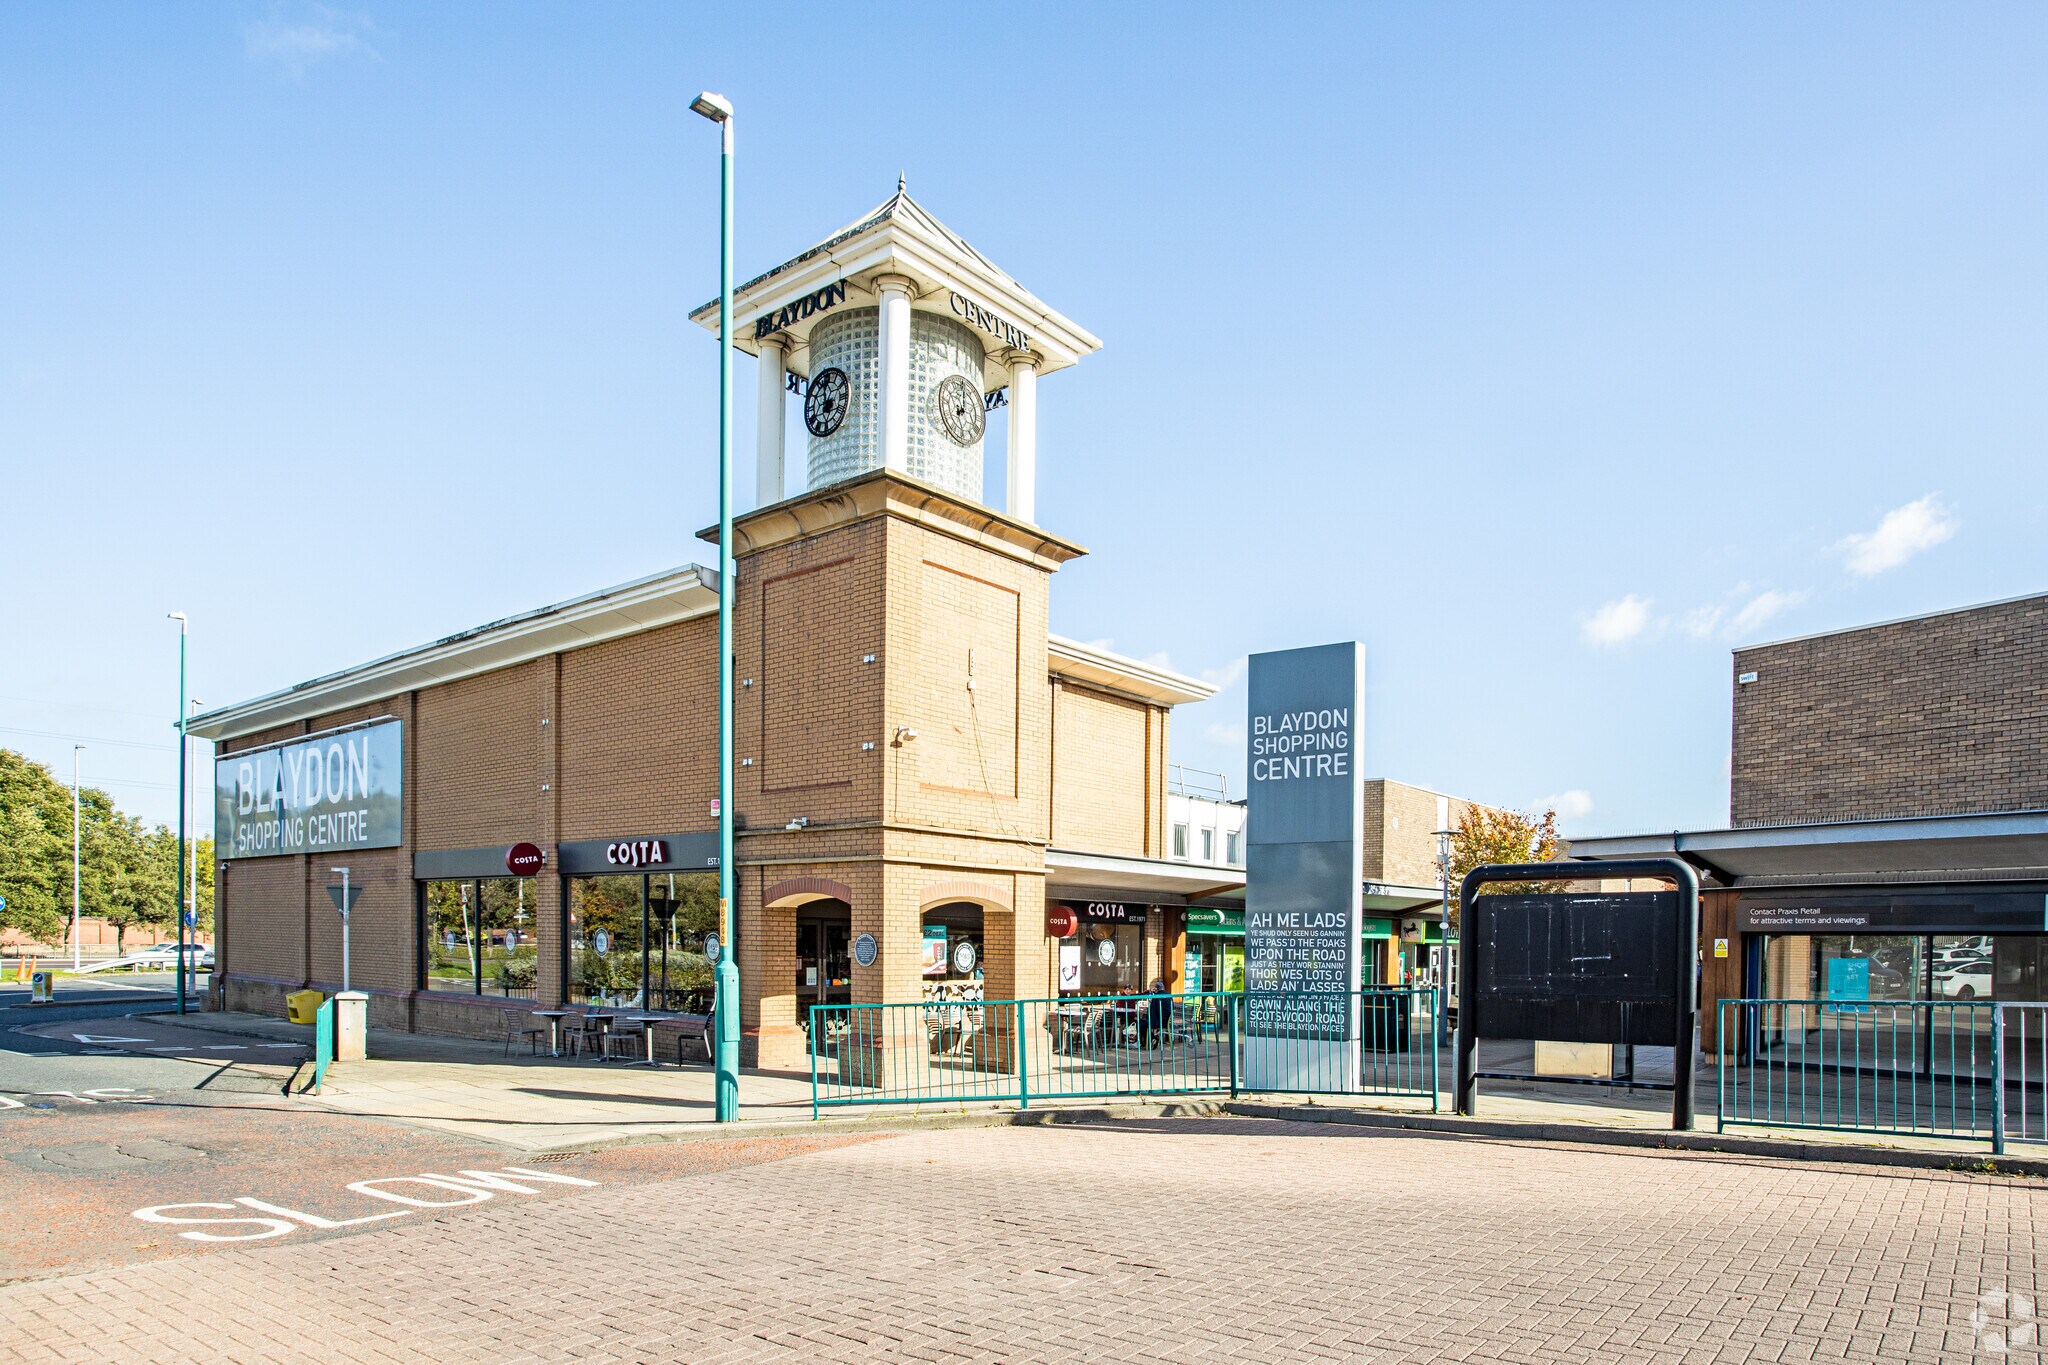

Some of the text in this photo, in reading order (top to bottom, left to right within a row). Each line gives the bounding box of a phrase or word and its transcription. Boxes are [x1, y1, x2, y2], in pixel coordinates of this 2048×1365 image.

[755, 278, 847, 339] BLAYDON
[950, 291, 1030, 353] CENTRE
[1254, 708, 1347, 735] BLAYDON
[1253, 731, 1348, 755] SHOPPING
[1253, 752, 1348, 781] CENTRE
[239, 736, 368, 816] BLAYDON
[239, 809, 368, 851] SHOPPING CENTRE
[514, 855, 538, 864] COSTA
[607, 840, 664, 867] COSTA
[1088, 903, 1125, 919] COSTA
[1187, 913, 1218, 922] Specsavers
[1750, 908, 1776, 916] Contact
[1800, 907, 1821, 915] Retail
[1250, 912, 1346, 928] AH ME LADS
[1833, 917, 1868, 926] viewings.
[1250, 929, 1258, 937] YE
[1250, 938, 1346, 948] WE PASS'D THE FOAKS
[1250, 948, 1346, 961] UPON THE ROAD
[1250, 960, 1267, 968] JUST
[1296, 961, 1312, 969] WOR
[1250, 968, 1346, 980] THOR WES LOTS O'
[1250, 980, 1345, 993] LADS AN' LASSES
[1249, 999, 1346, 1013] GAWN ALANG THE
[1249, 1010, 1345, 1024] SCOTSWOOD ROAD
[1259, 1021, 1273, 1029] SEE
[1273, 1022, 1287, 1030] THE
[1288, 1023, 1320, 1031] BLAYDON
[1321, 1024, 1345, 1033] RACES
[132, 1167, 601, 1242] SLOW
